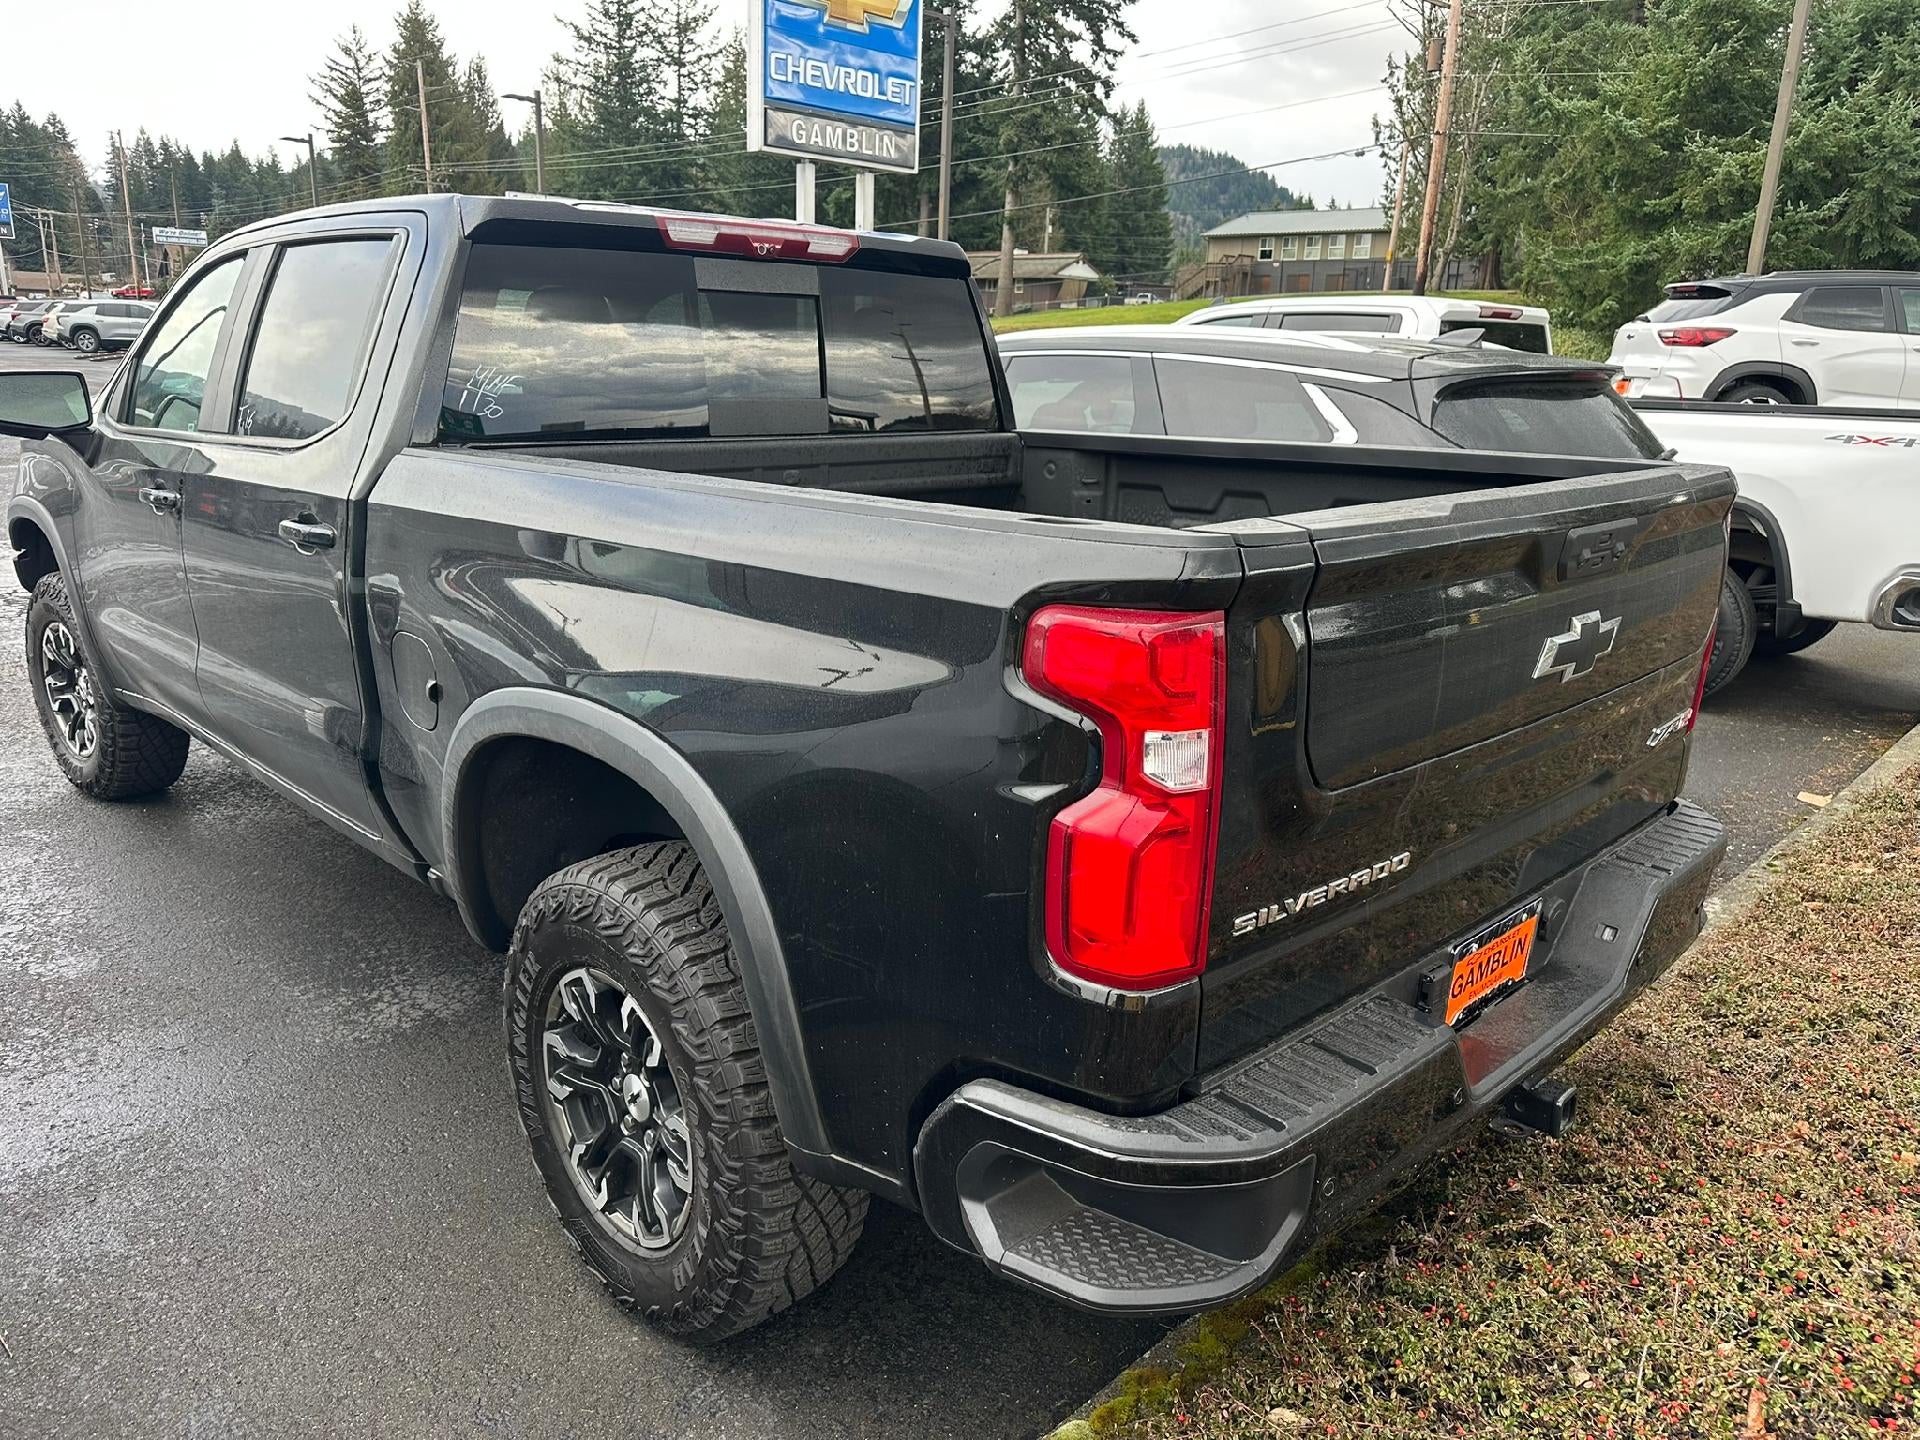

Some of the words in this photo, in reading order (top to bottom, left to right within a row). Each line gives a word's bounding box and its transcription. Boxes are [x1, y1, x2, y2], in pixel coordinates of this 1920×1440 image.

[769, 51, 916, 106] CHEVROLET
[791, 119, 897, 160] GAMBLIN
[1231, 851, 1412, 937] SILVERADO
[1451, 932, 1529, 999] GAMBLIN
[512, 950, 545, 1139] WRANGLER
